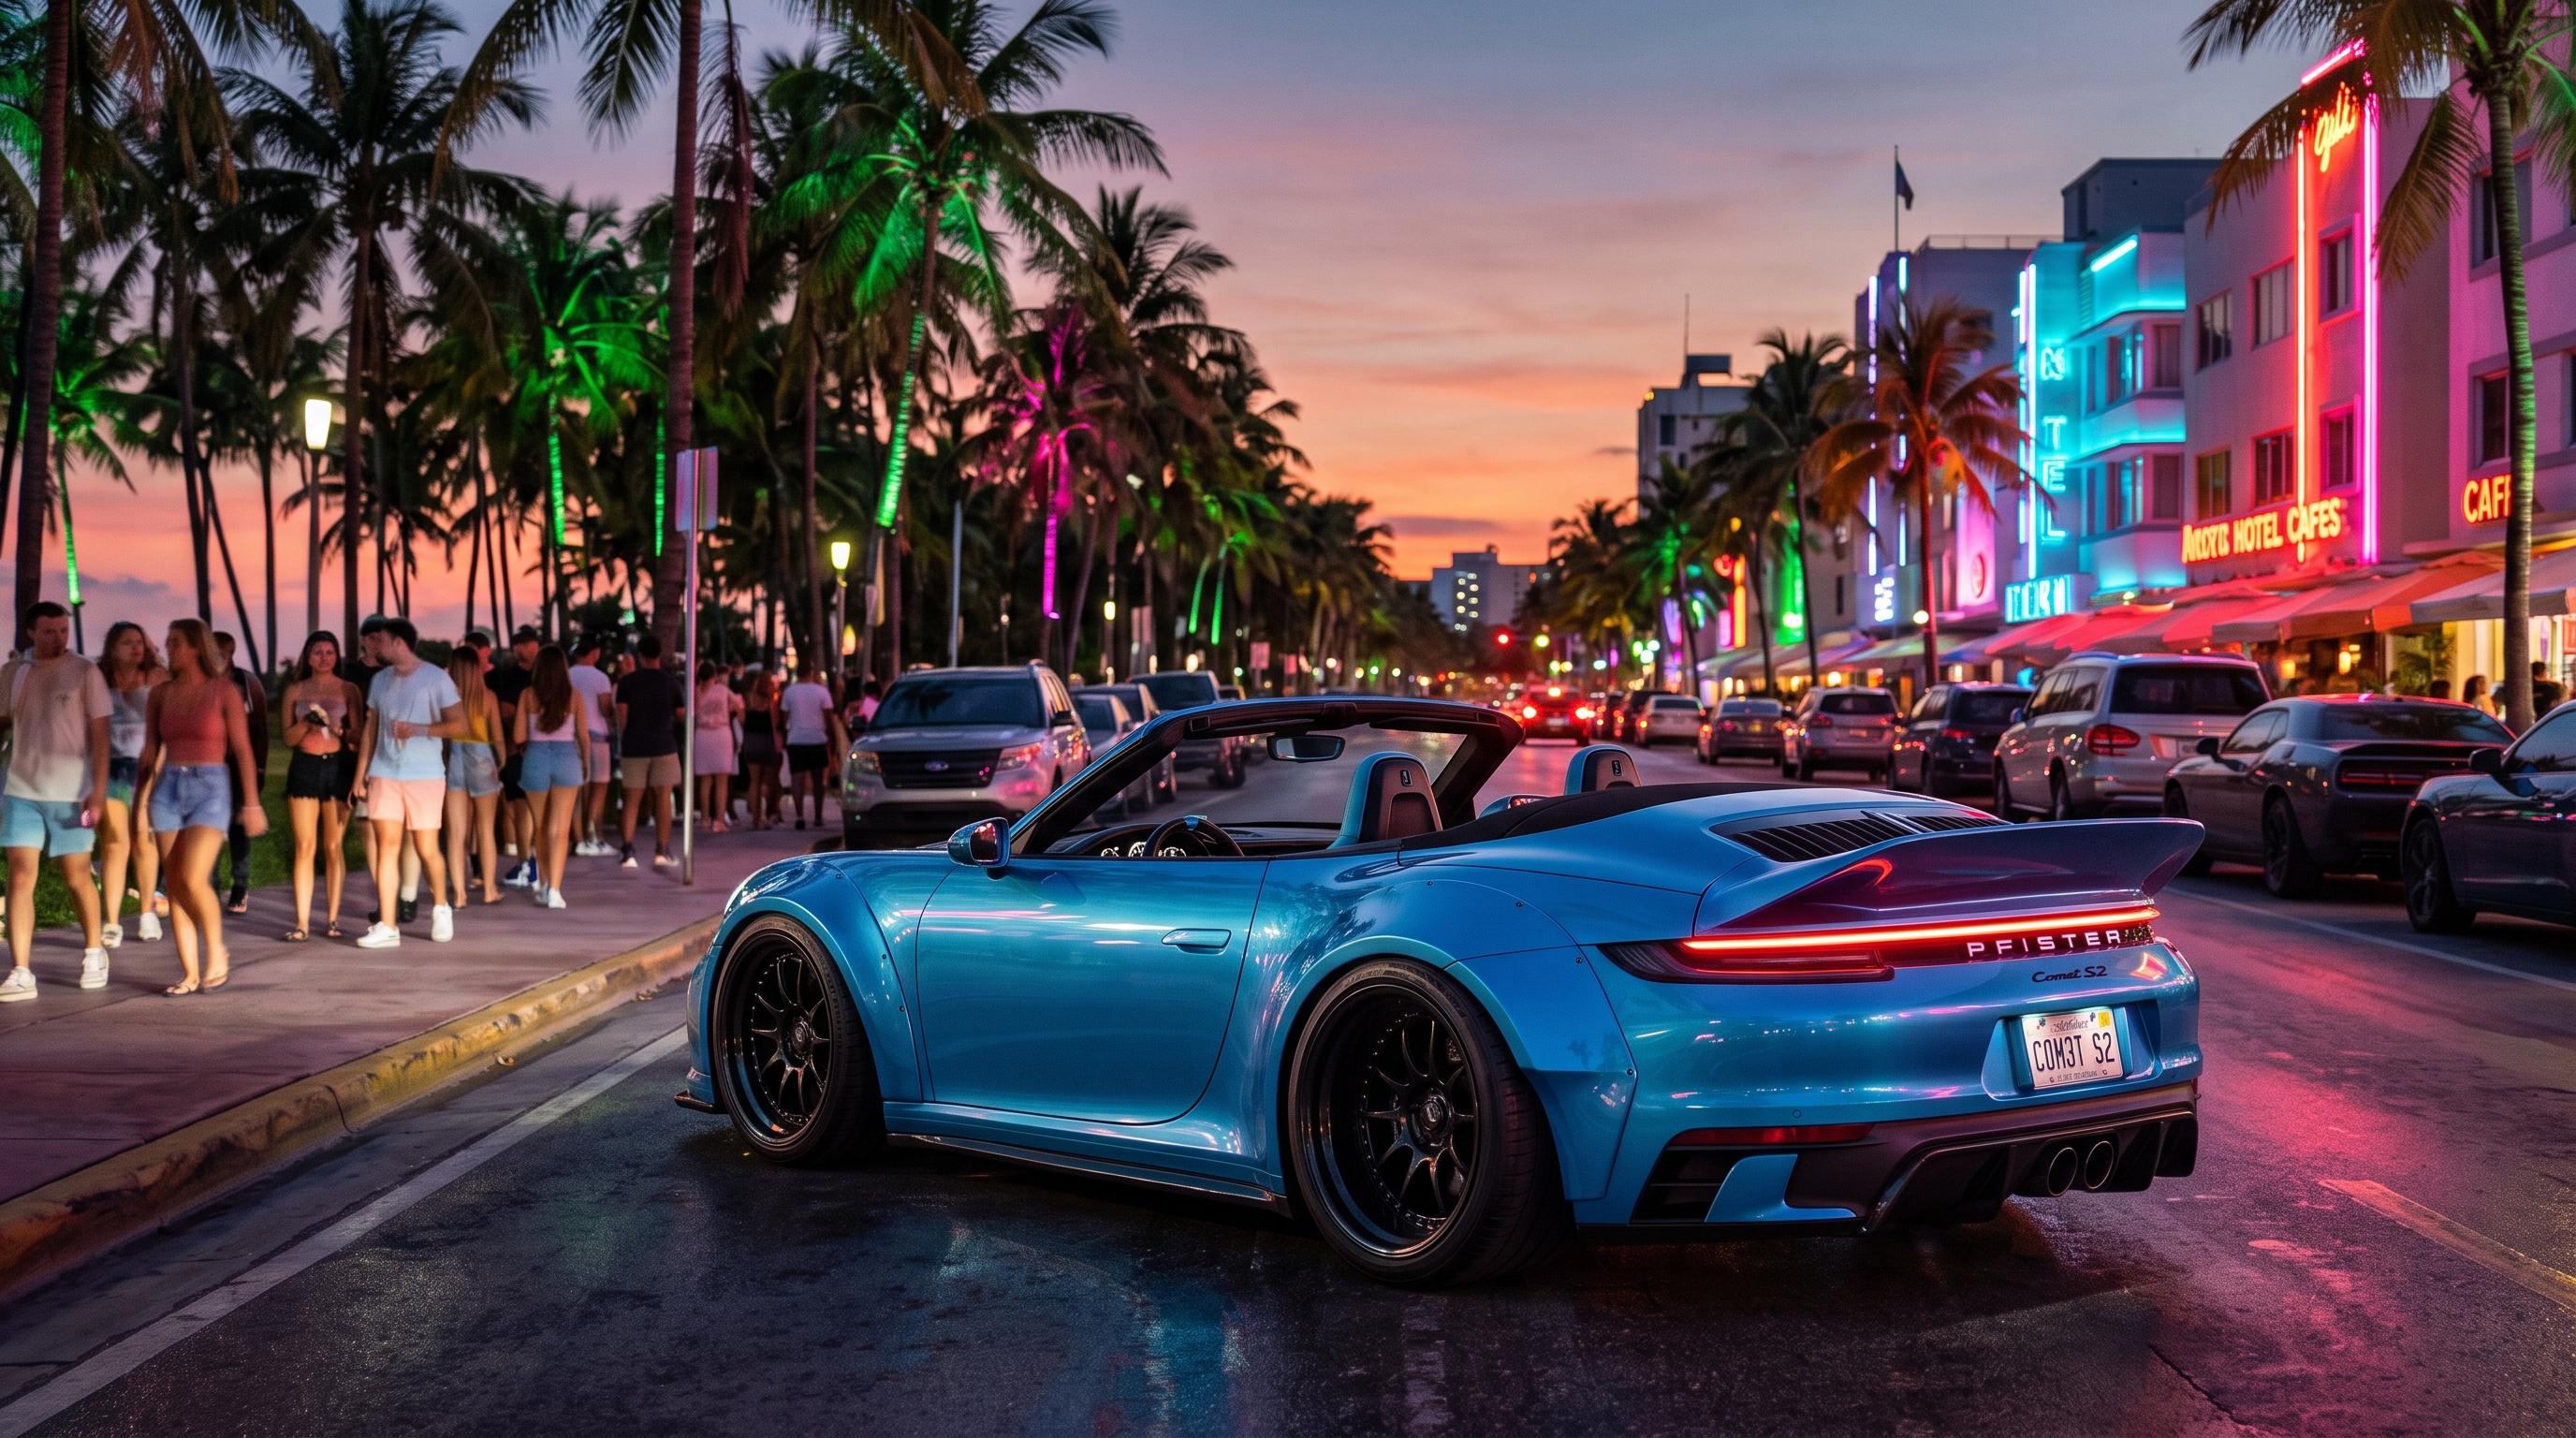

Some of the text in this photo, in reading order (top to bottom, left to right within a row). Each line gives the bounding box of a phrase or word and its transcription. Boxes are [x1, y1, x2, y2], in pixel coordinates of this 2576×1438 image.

[2232, 511, 2284, 554] HOTEL
[2287, 497, 2341, 543] CAFES
[1967, 930, 2121, 957] PFISTER
[2032, 965, 2108, 983] Comet S2
[2033, 1032, 2115, 1072] COM3T S2
